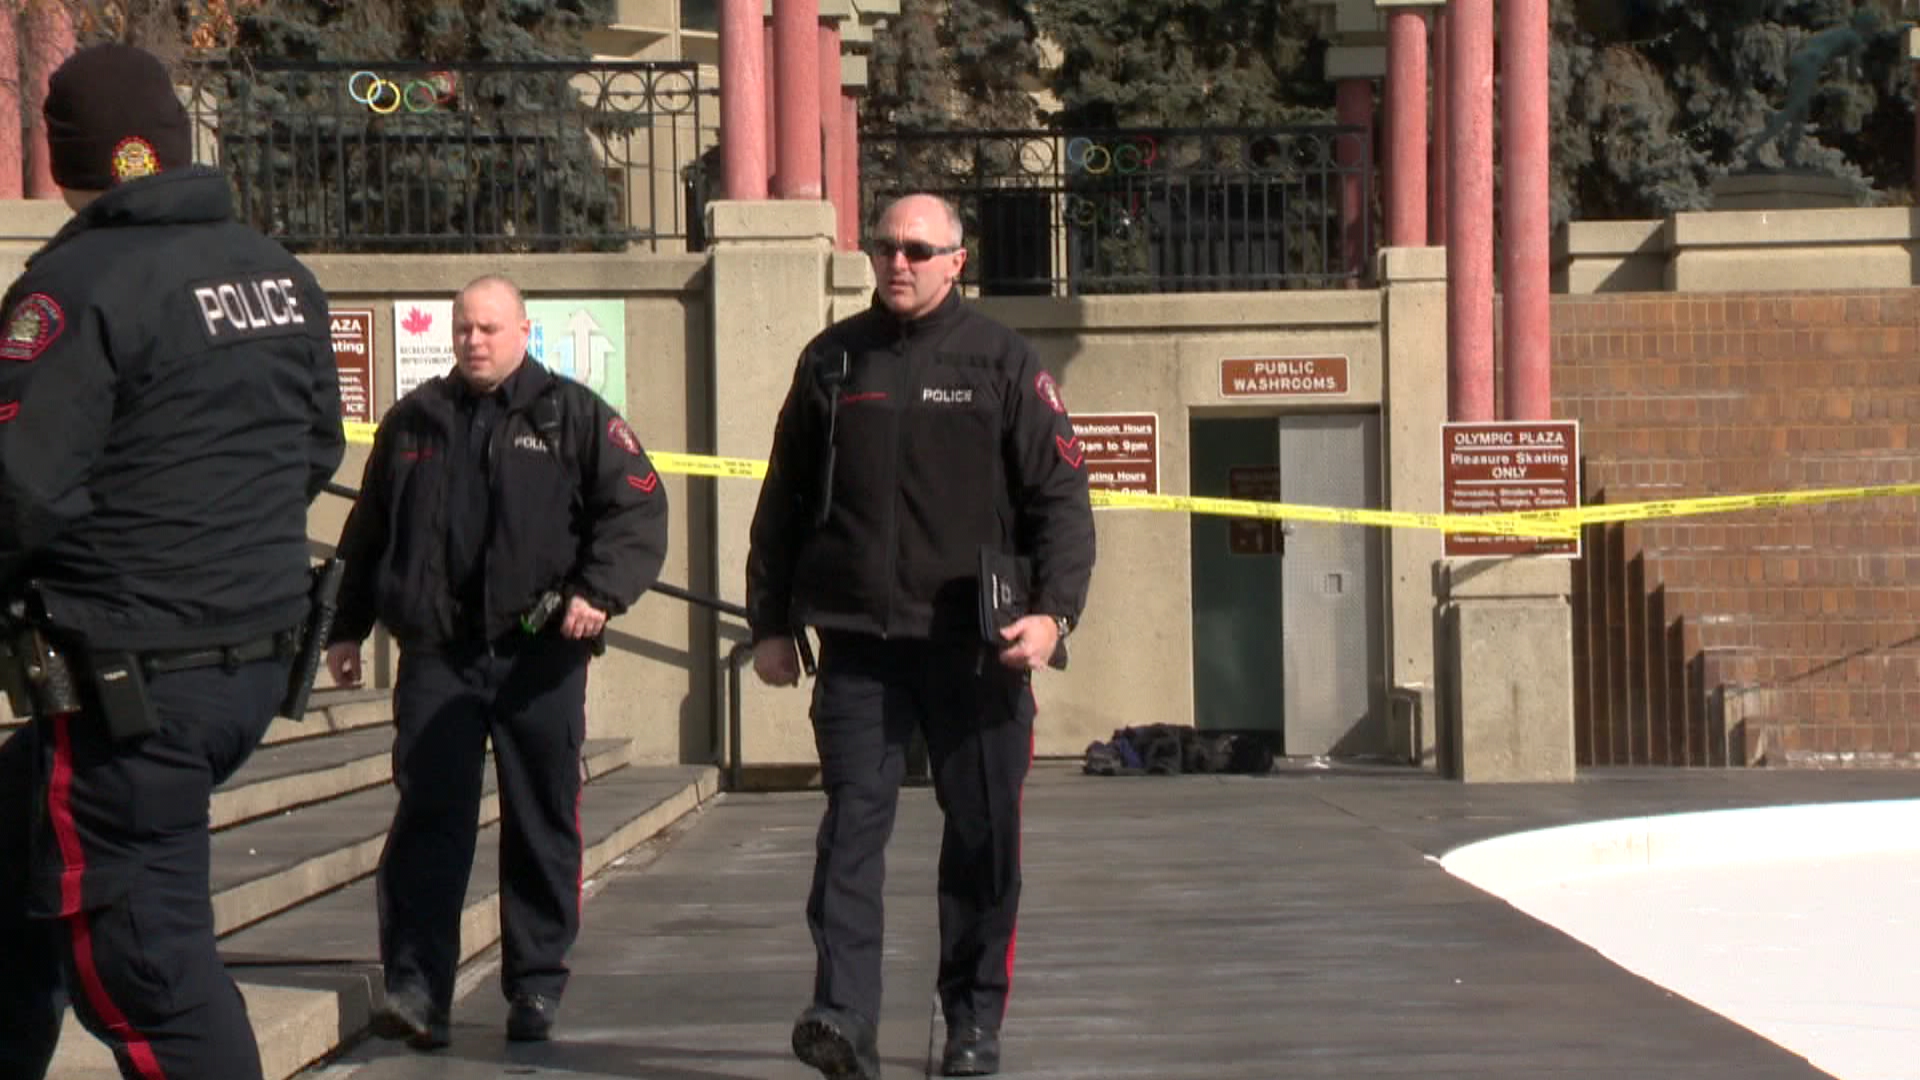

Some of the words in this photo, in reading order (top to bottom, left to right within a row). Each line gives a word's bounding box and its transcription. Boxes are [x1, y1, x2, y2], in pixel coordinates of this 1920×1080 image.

[195, 279, 304, 335] POLICE
[330, 318, 362, 332] AZA
[1254, 361, 1315, 375] PUBLIC
[1233, 376, 1337, 392] WASHROOMS
[922, 388, 973, 403] POLICE
[1123, 423, 1153, 434] Hours
[513, 433, 548, 453] POLI
[1454, 432, 1513, 445] OLYMPIC
[1519, 431, 1565, 444] PLAZA
[1106, 441, 1119, 451] to
[1122, 440, 1149, 453] 9pm
[1451, 453, 1511, 465] Pleasure
[1515, 451, 1569, 471] Skating
[1088, 471, 1115, 487] ating
[1117, 471, 1147, 482] Hours
[1491, 466, 1528, 479] ONLY
